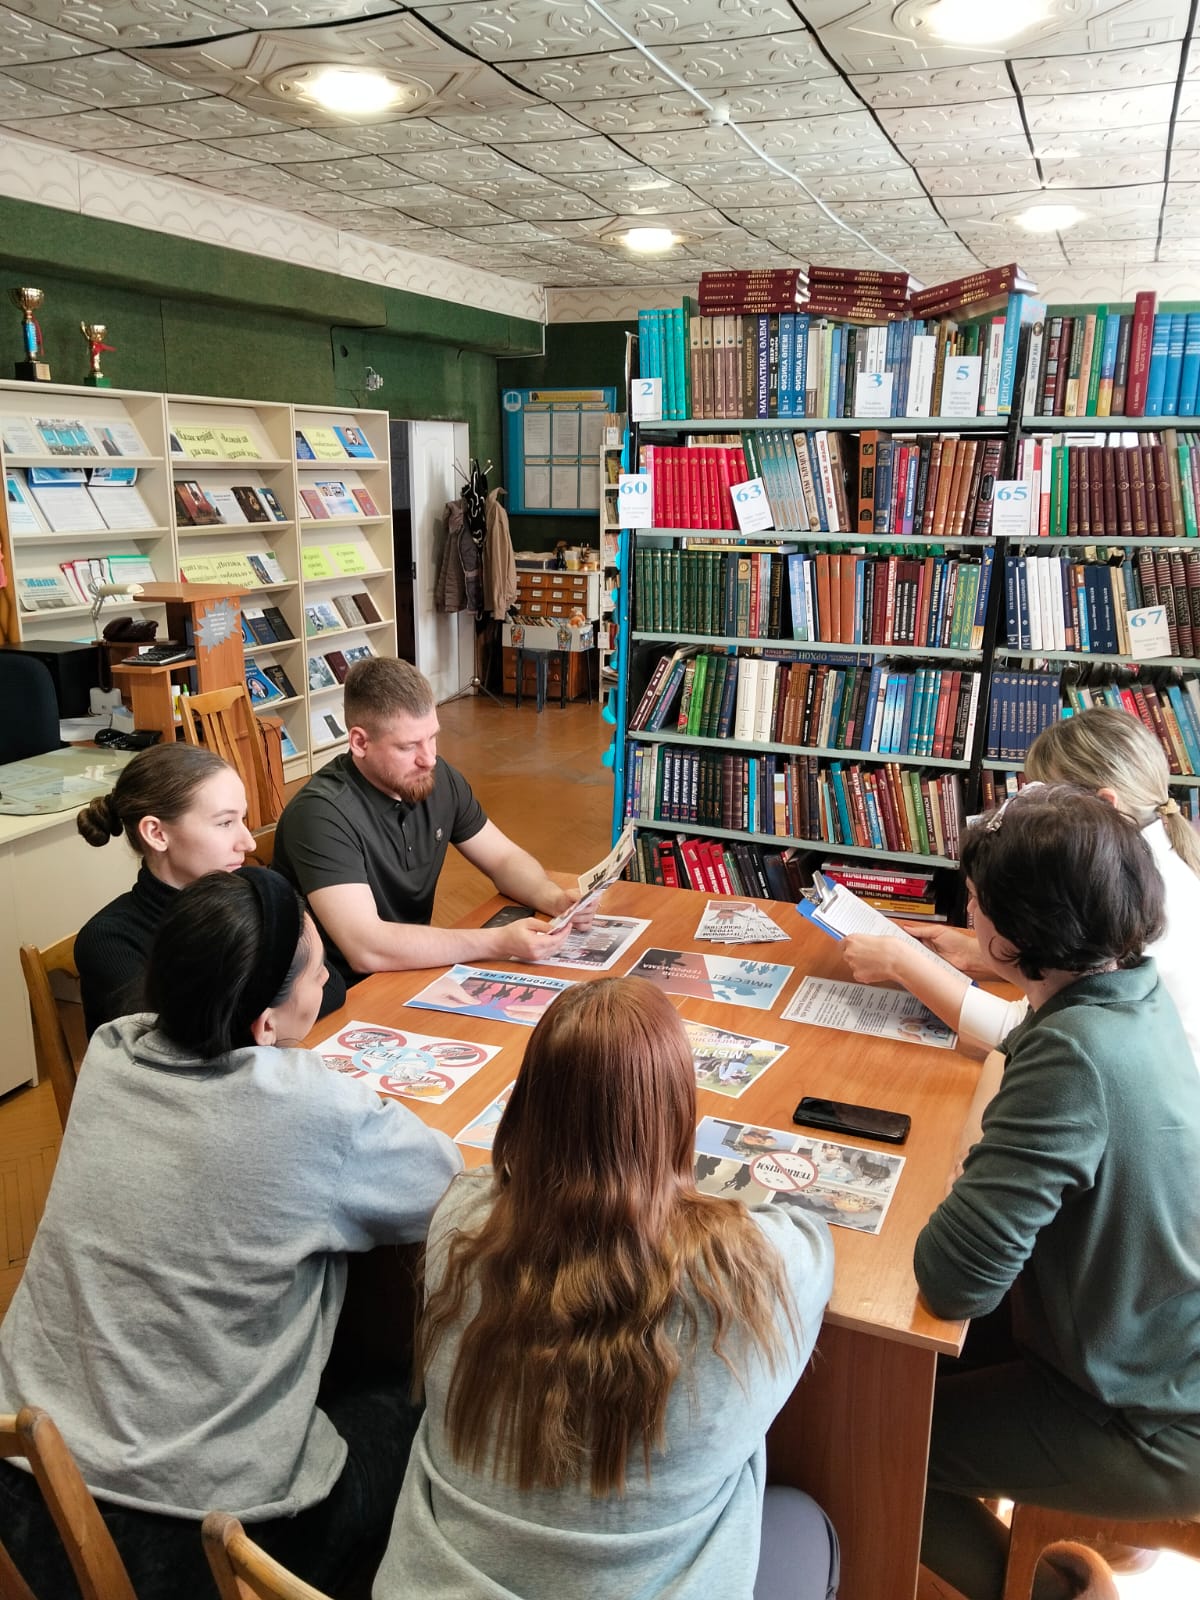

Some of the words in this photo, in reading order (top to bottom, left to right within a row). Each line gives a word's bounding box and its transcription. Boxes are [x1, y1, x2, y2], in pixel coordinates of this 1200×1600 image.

[781, 359, 789, 391] ФИЗИКА
[795, 359, 803, 391] ФИЗИКА
[867, 373, 883, 389] 3
[956, 365, 970, 381] 5
[640, 382, 655, 396] 2
[759, 351, 768, 414] МАТЕМАТИКА
[620, 480, 648, 495] 60
[735, 484, 762, 503] 63
[997, 485, 1028, 502] 65
[1130, 609, 1163, 629] 67
[642, 963, 702, 975] ТЕРРОРИЗМА
[661, 970, 699, 980] ПРОТИВ
[499, 973, 565, 989] ТЕРРОРИЗМУ
[712, 973, 773, 989] ВМЕСТЕ!
[756, 1161, 811, 1181] TERRORISM
